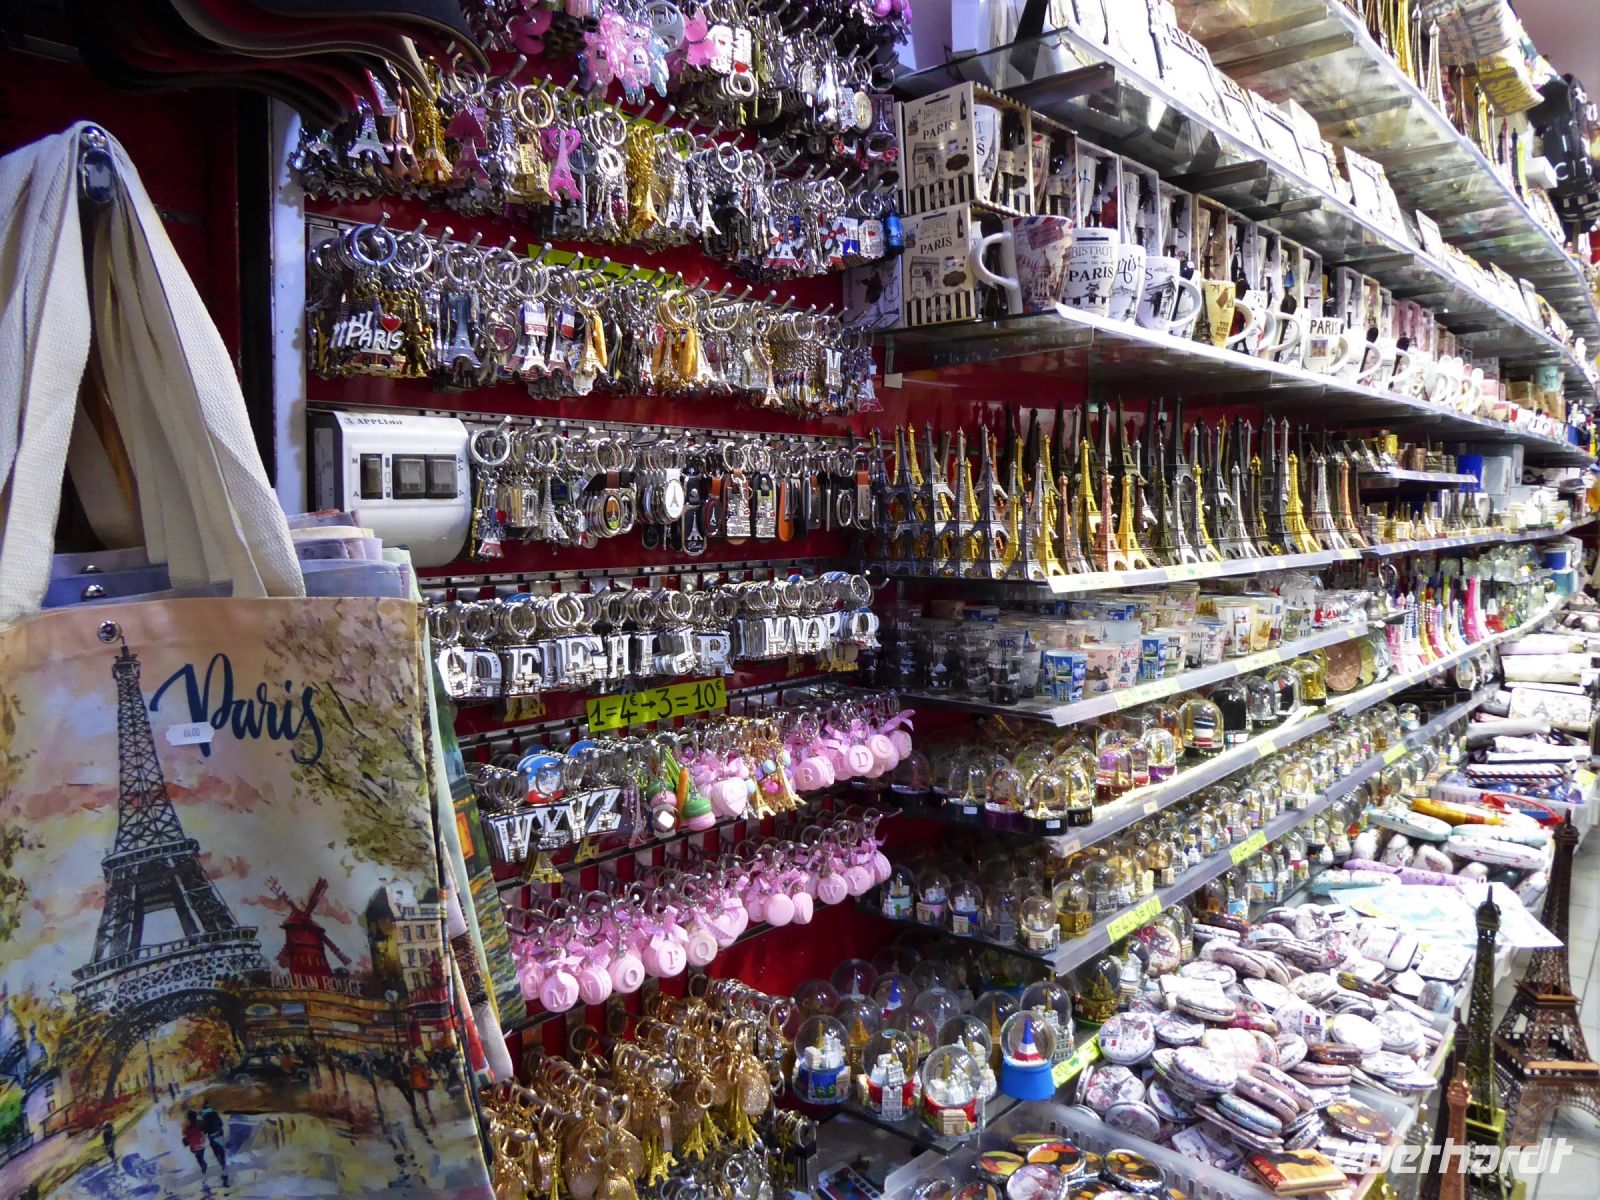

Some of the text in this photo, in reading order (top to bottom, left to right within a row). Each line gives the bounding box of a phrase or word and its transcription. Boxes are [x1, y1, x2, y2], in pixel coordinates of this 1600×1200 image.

[920, 236, 953, 255] PARIS
[1068, 266, 1114, 282] PARIS
[345, 322, 405, 351] PARIS
[1309, 318, 1340, 335] PARIS
[150, 653, 323, 765] Paris
[270, 973, 363, 997] MOULIN ROUGE
